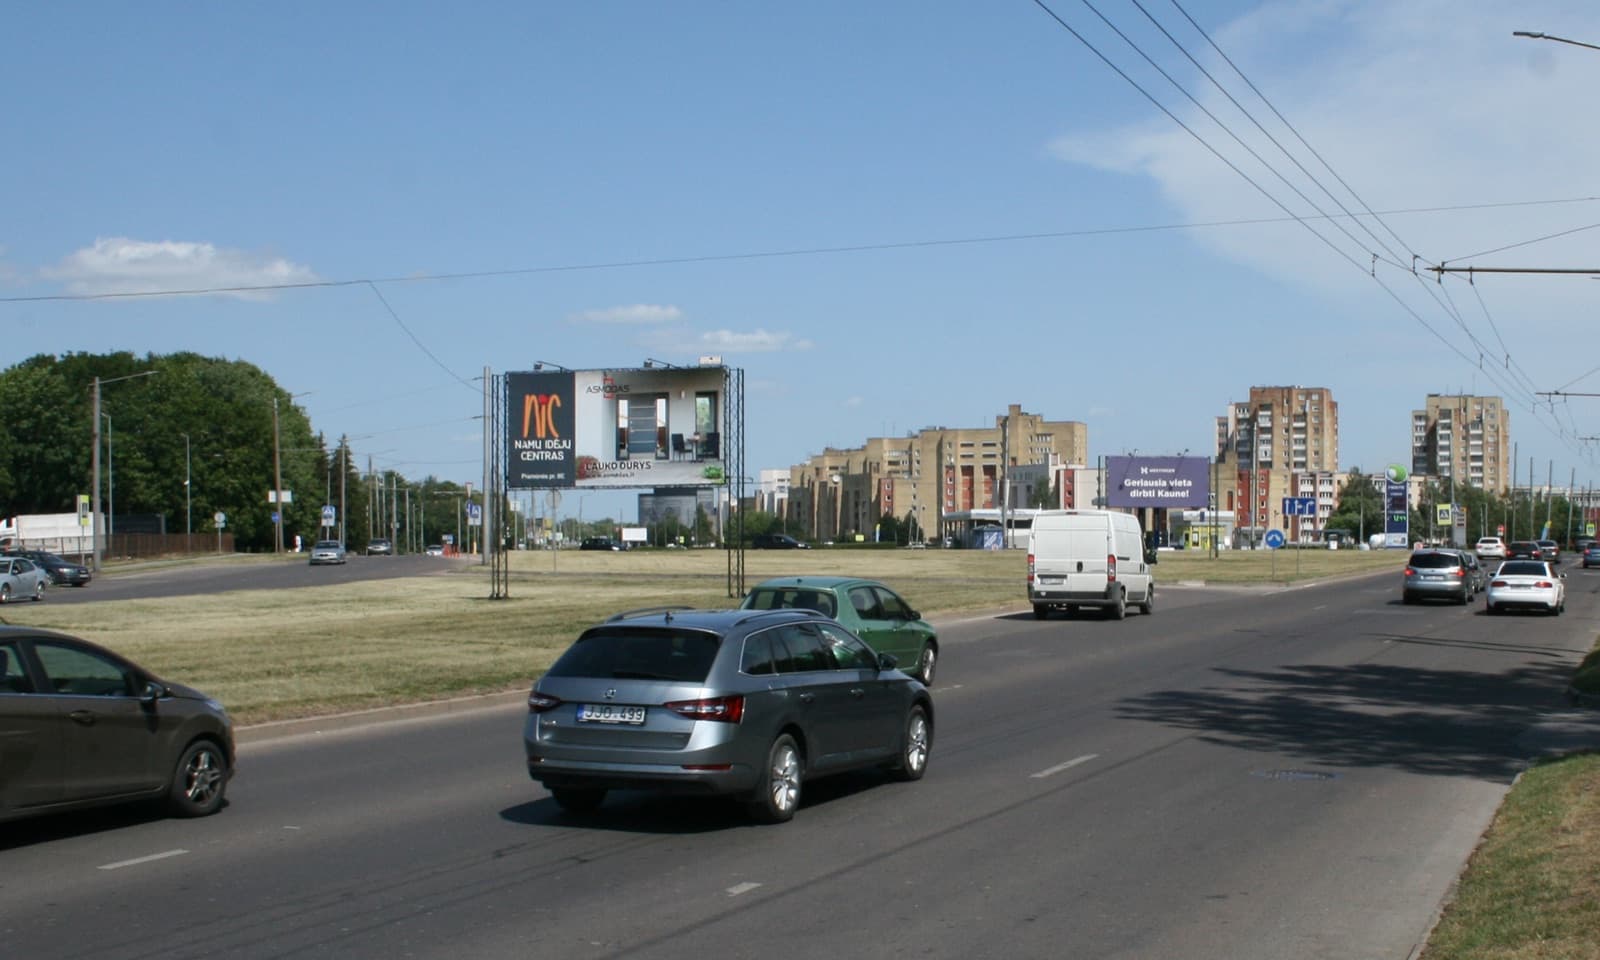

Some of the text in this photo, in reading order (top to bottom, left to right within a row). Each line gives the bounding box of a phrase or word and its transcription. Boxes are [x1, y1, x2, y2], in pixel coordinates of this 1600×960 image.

[520, 451, 565, 461] CENTRAS
[585, 461, 618, 471] LAUKO
[1124, 478, 1193, 487] Geriausia vieta
[1129, 489, 1190, 498] dirbti Kaune!
